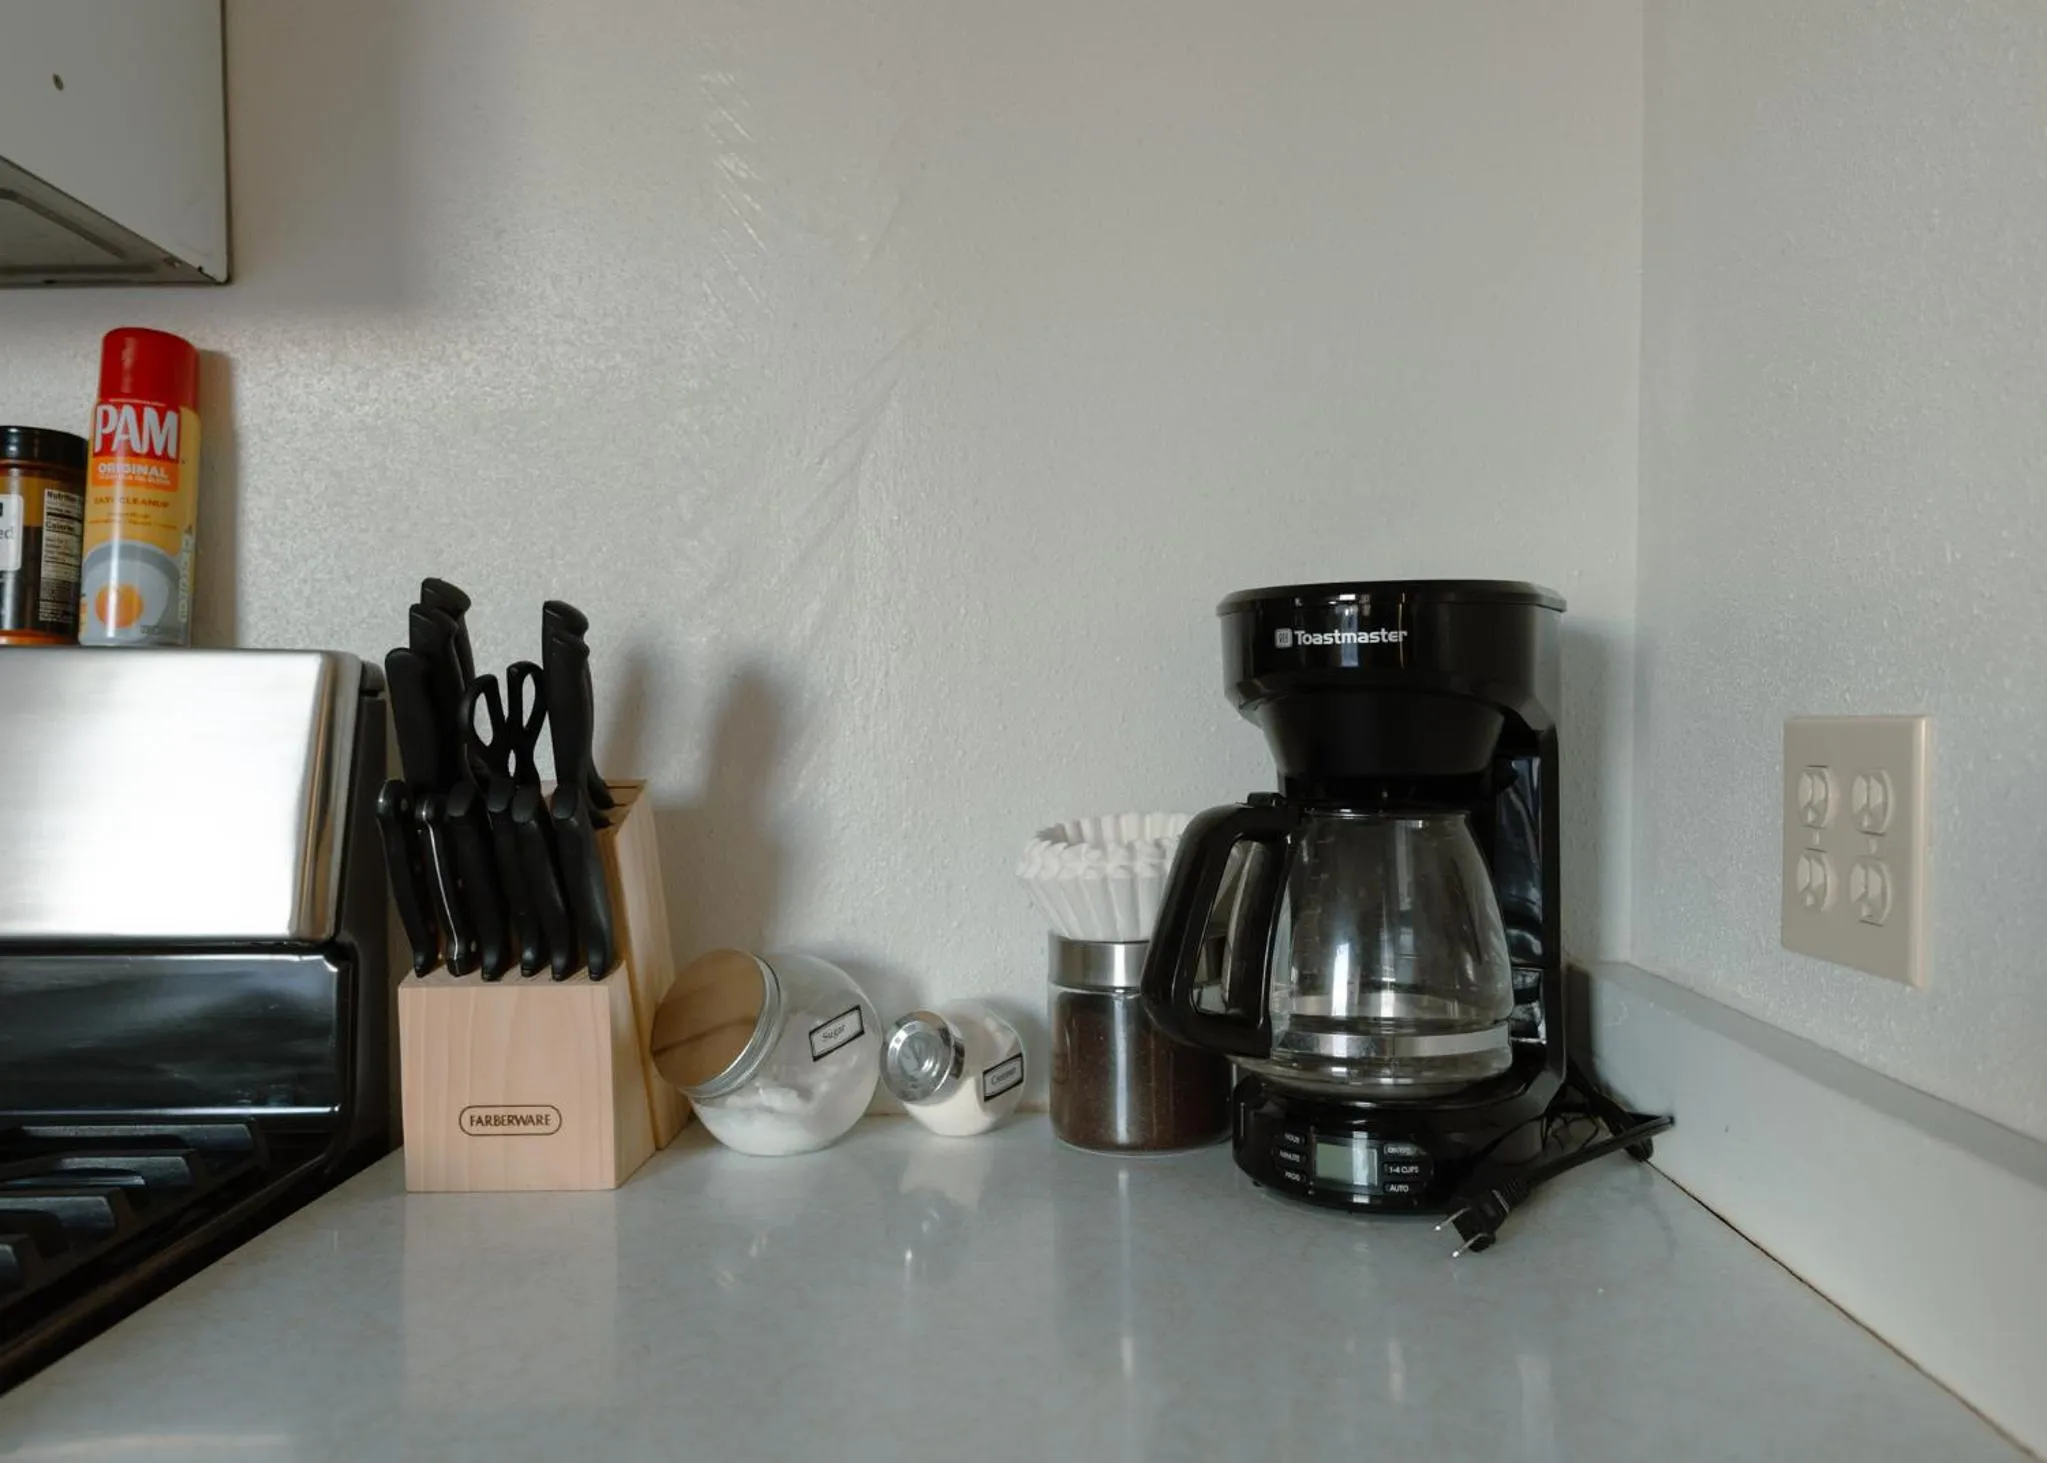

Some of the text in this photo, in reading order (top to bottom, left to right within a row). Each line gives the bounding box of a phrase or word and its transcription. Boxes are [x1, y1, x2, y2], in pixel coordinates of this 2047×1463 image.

[94, 404, 179, 459] PAM
[98, 462, 169, 478] ORIGINAL
[1294, 628, 1408, 645] Toastmaster
[469, 1114, 552, 1127] FARBERWARE
[1389, 1183, 1409, 1193] AUTO
